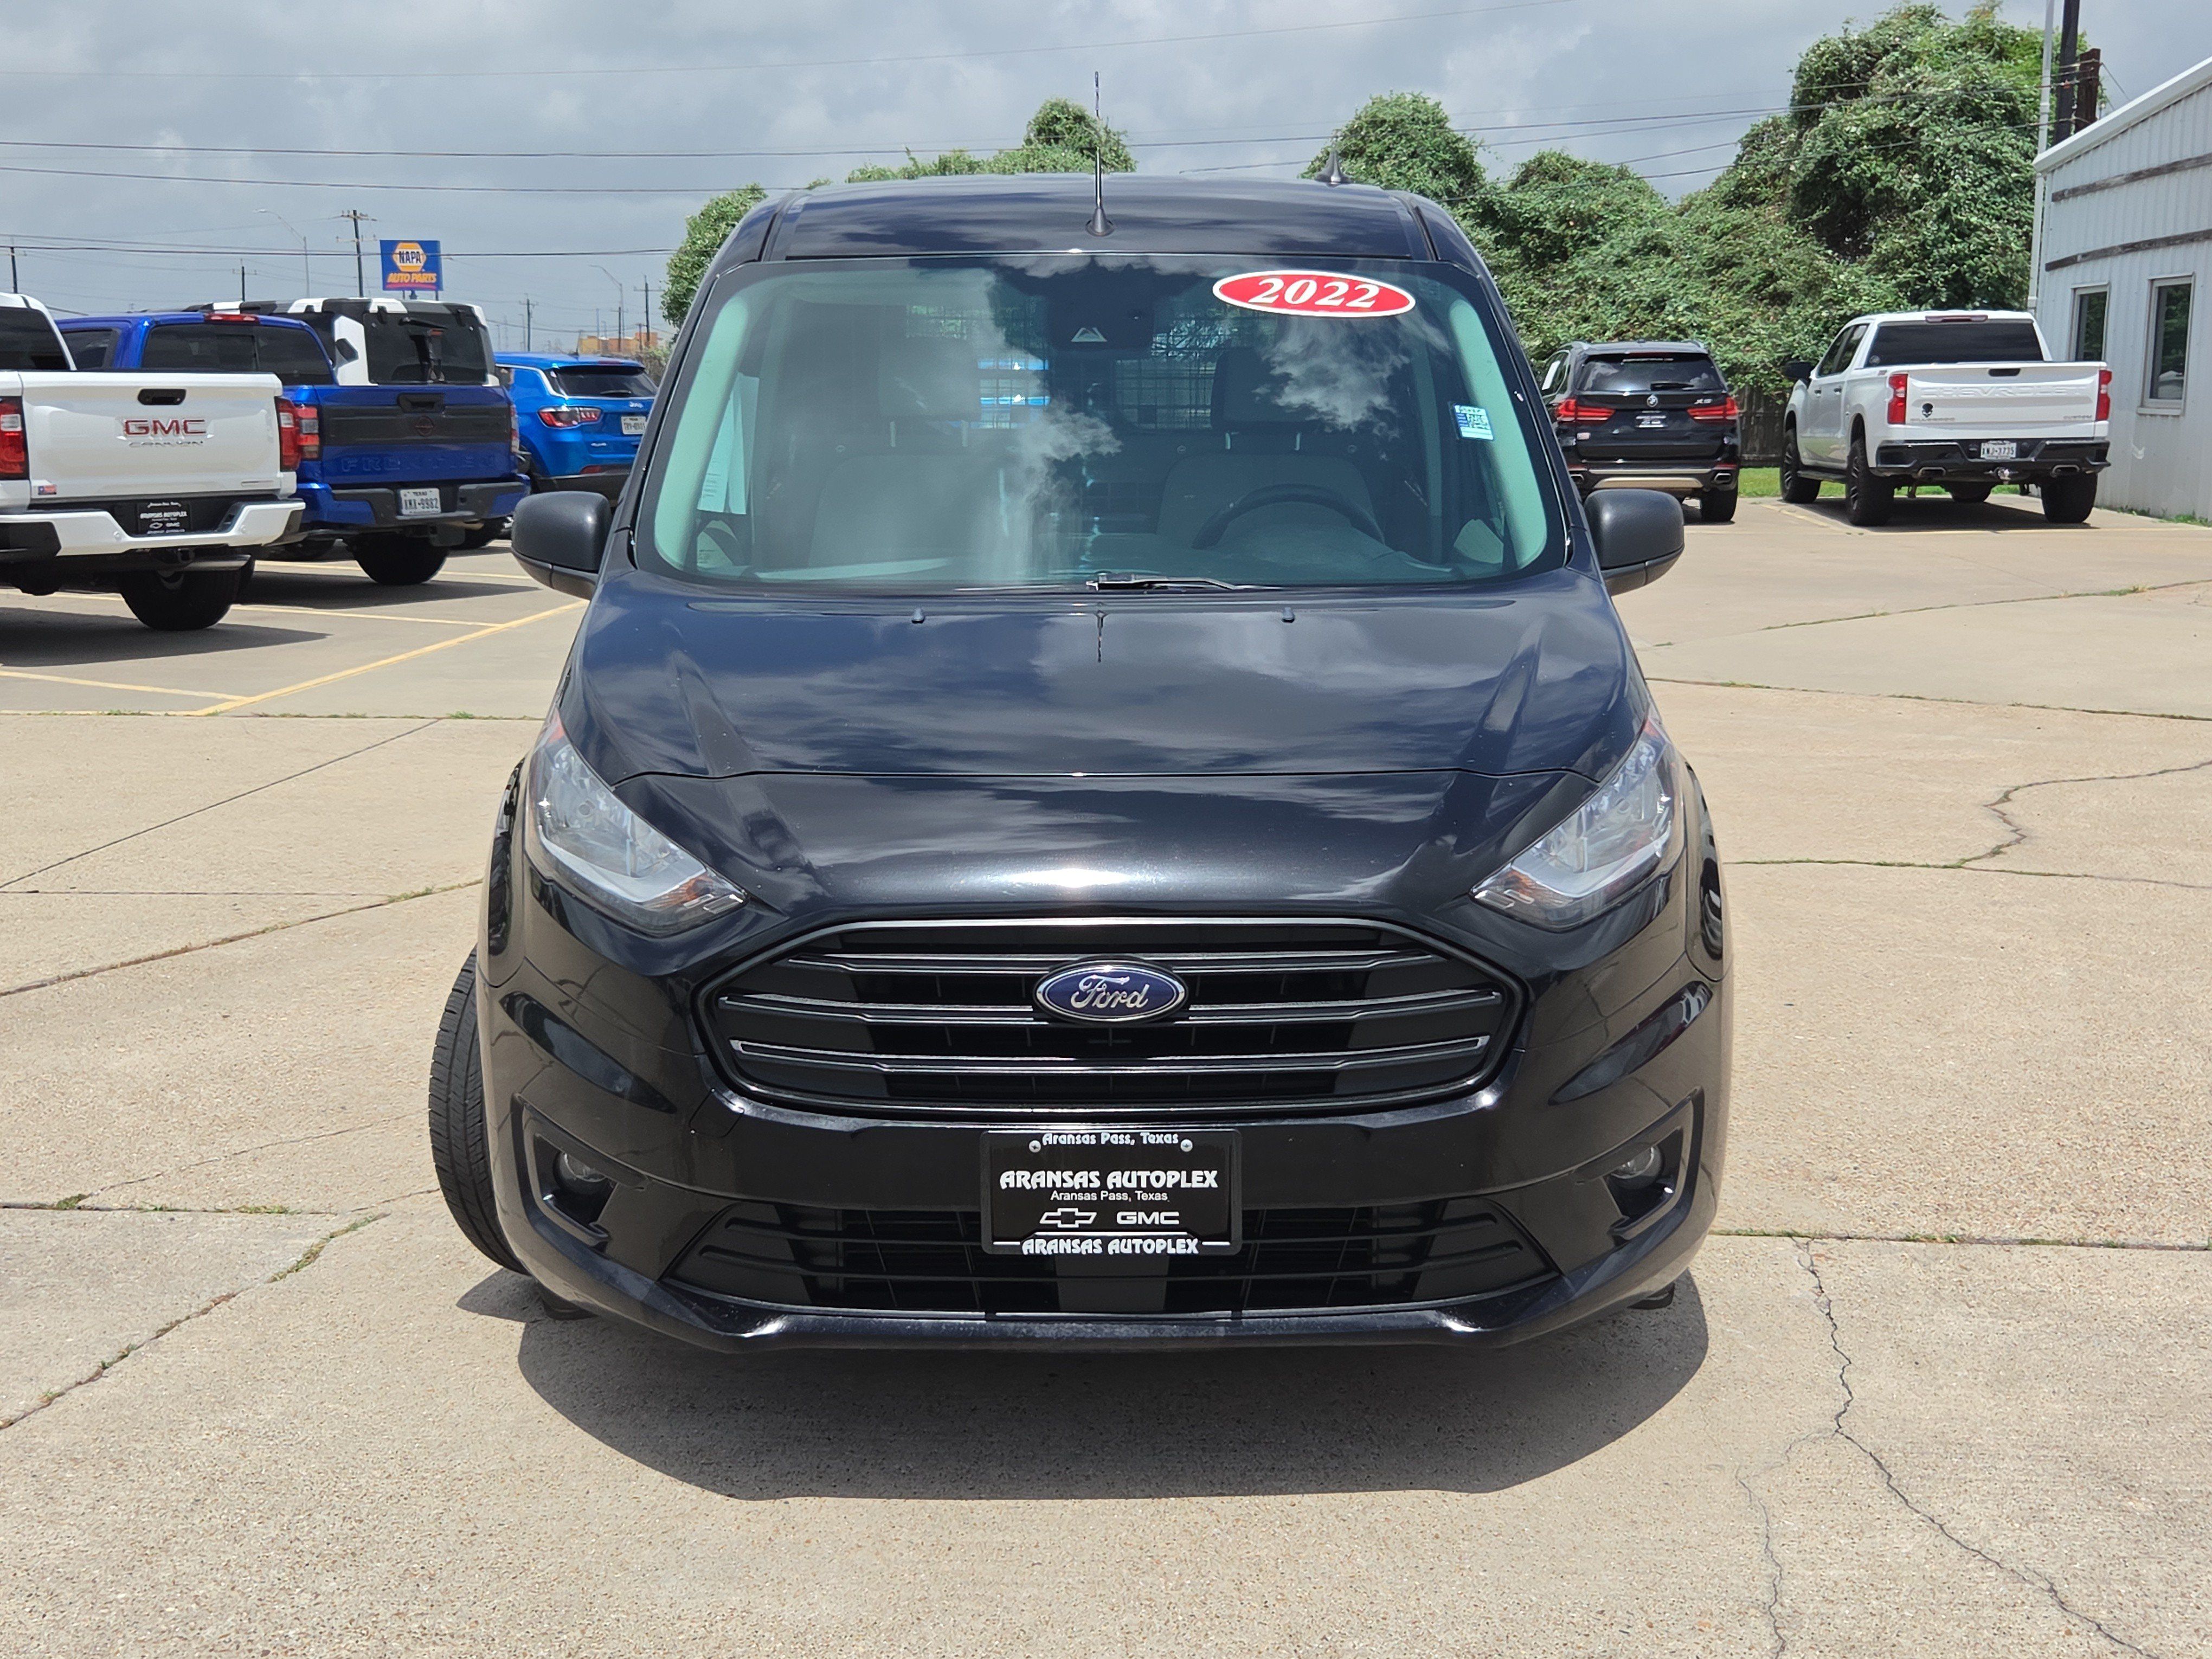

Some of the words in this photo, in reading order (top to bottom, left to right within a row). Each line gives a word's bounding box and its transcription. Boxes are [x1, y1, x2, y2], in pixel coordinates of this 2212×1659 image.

[398, 250, 422, 264] NAPA
[387, 272, 411, 283] AUTO
[411, 272, 437, 283] PARTS
[1248, 277, 1380, 308] 2022
[124, 419, 207, 436] GMC
[1070, 974, 1150, 1009] Ford
[1042, 1132, 1096, 1145] Aransas
[1101, 1132, 1135, 1146] Pass,
[1140, 1132, 1179, 1144] Texas
[999, 1170, 1101, 1190] ARANSAS
[1107, 1170, 1219, 1190] AUTOPLEX
[1050, 1190, 1097, 1201] Aransas
[1101, 1190, 1132, 1203] Pass,
[1134, 1190, 1168, 1201] Texas
[1116, 1211, 1180, 1225] GMC
[1021, 1238, 1103, 1256] ARANSAS
[1108, 1238, 1199, 1255] AUTOPLEX
